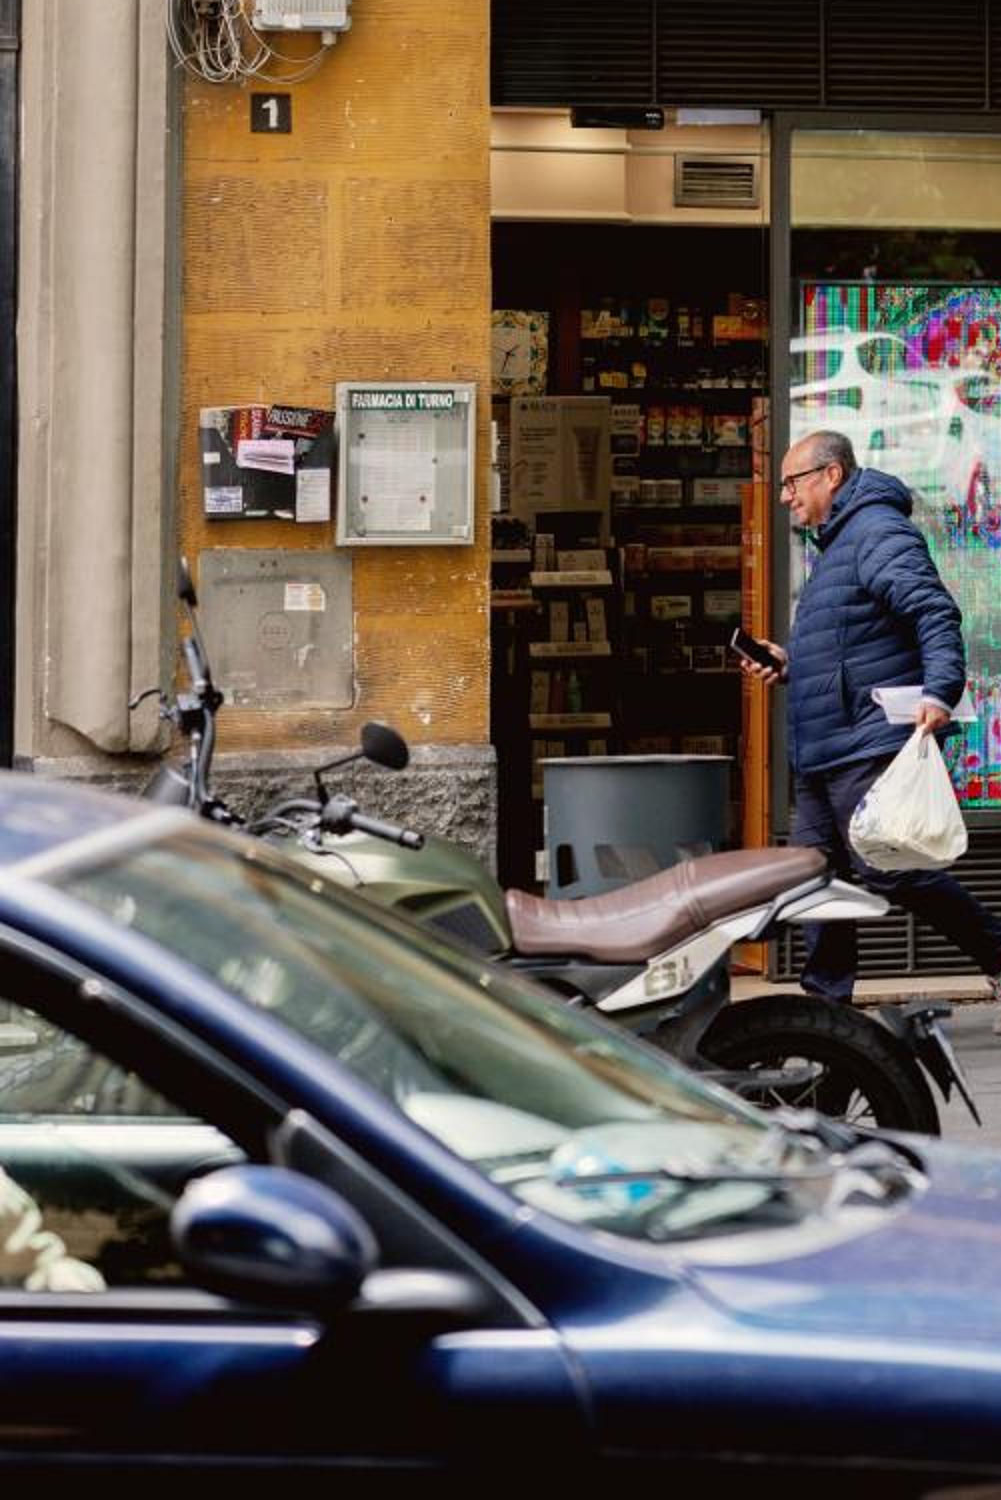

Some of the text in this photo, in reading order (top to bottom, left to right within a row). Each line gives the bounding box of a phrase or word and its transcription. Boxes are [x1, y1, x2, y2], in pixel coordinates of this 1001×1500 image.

[261, 98, 280, 129] 1
[351, 392, 454, 409] FARMACIA DI TURNO
